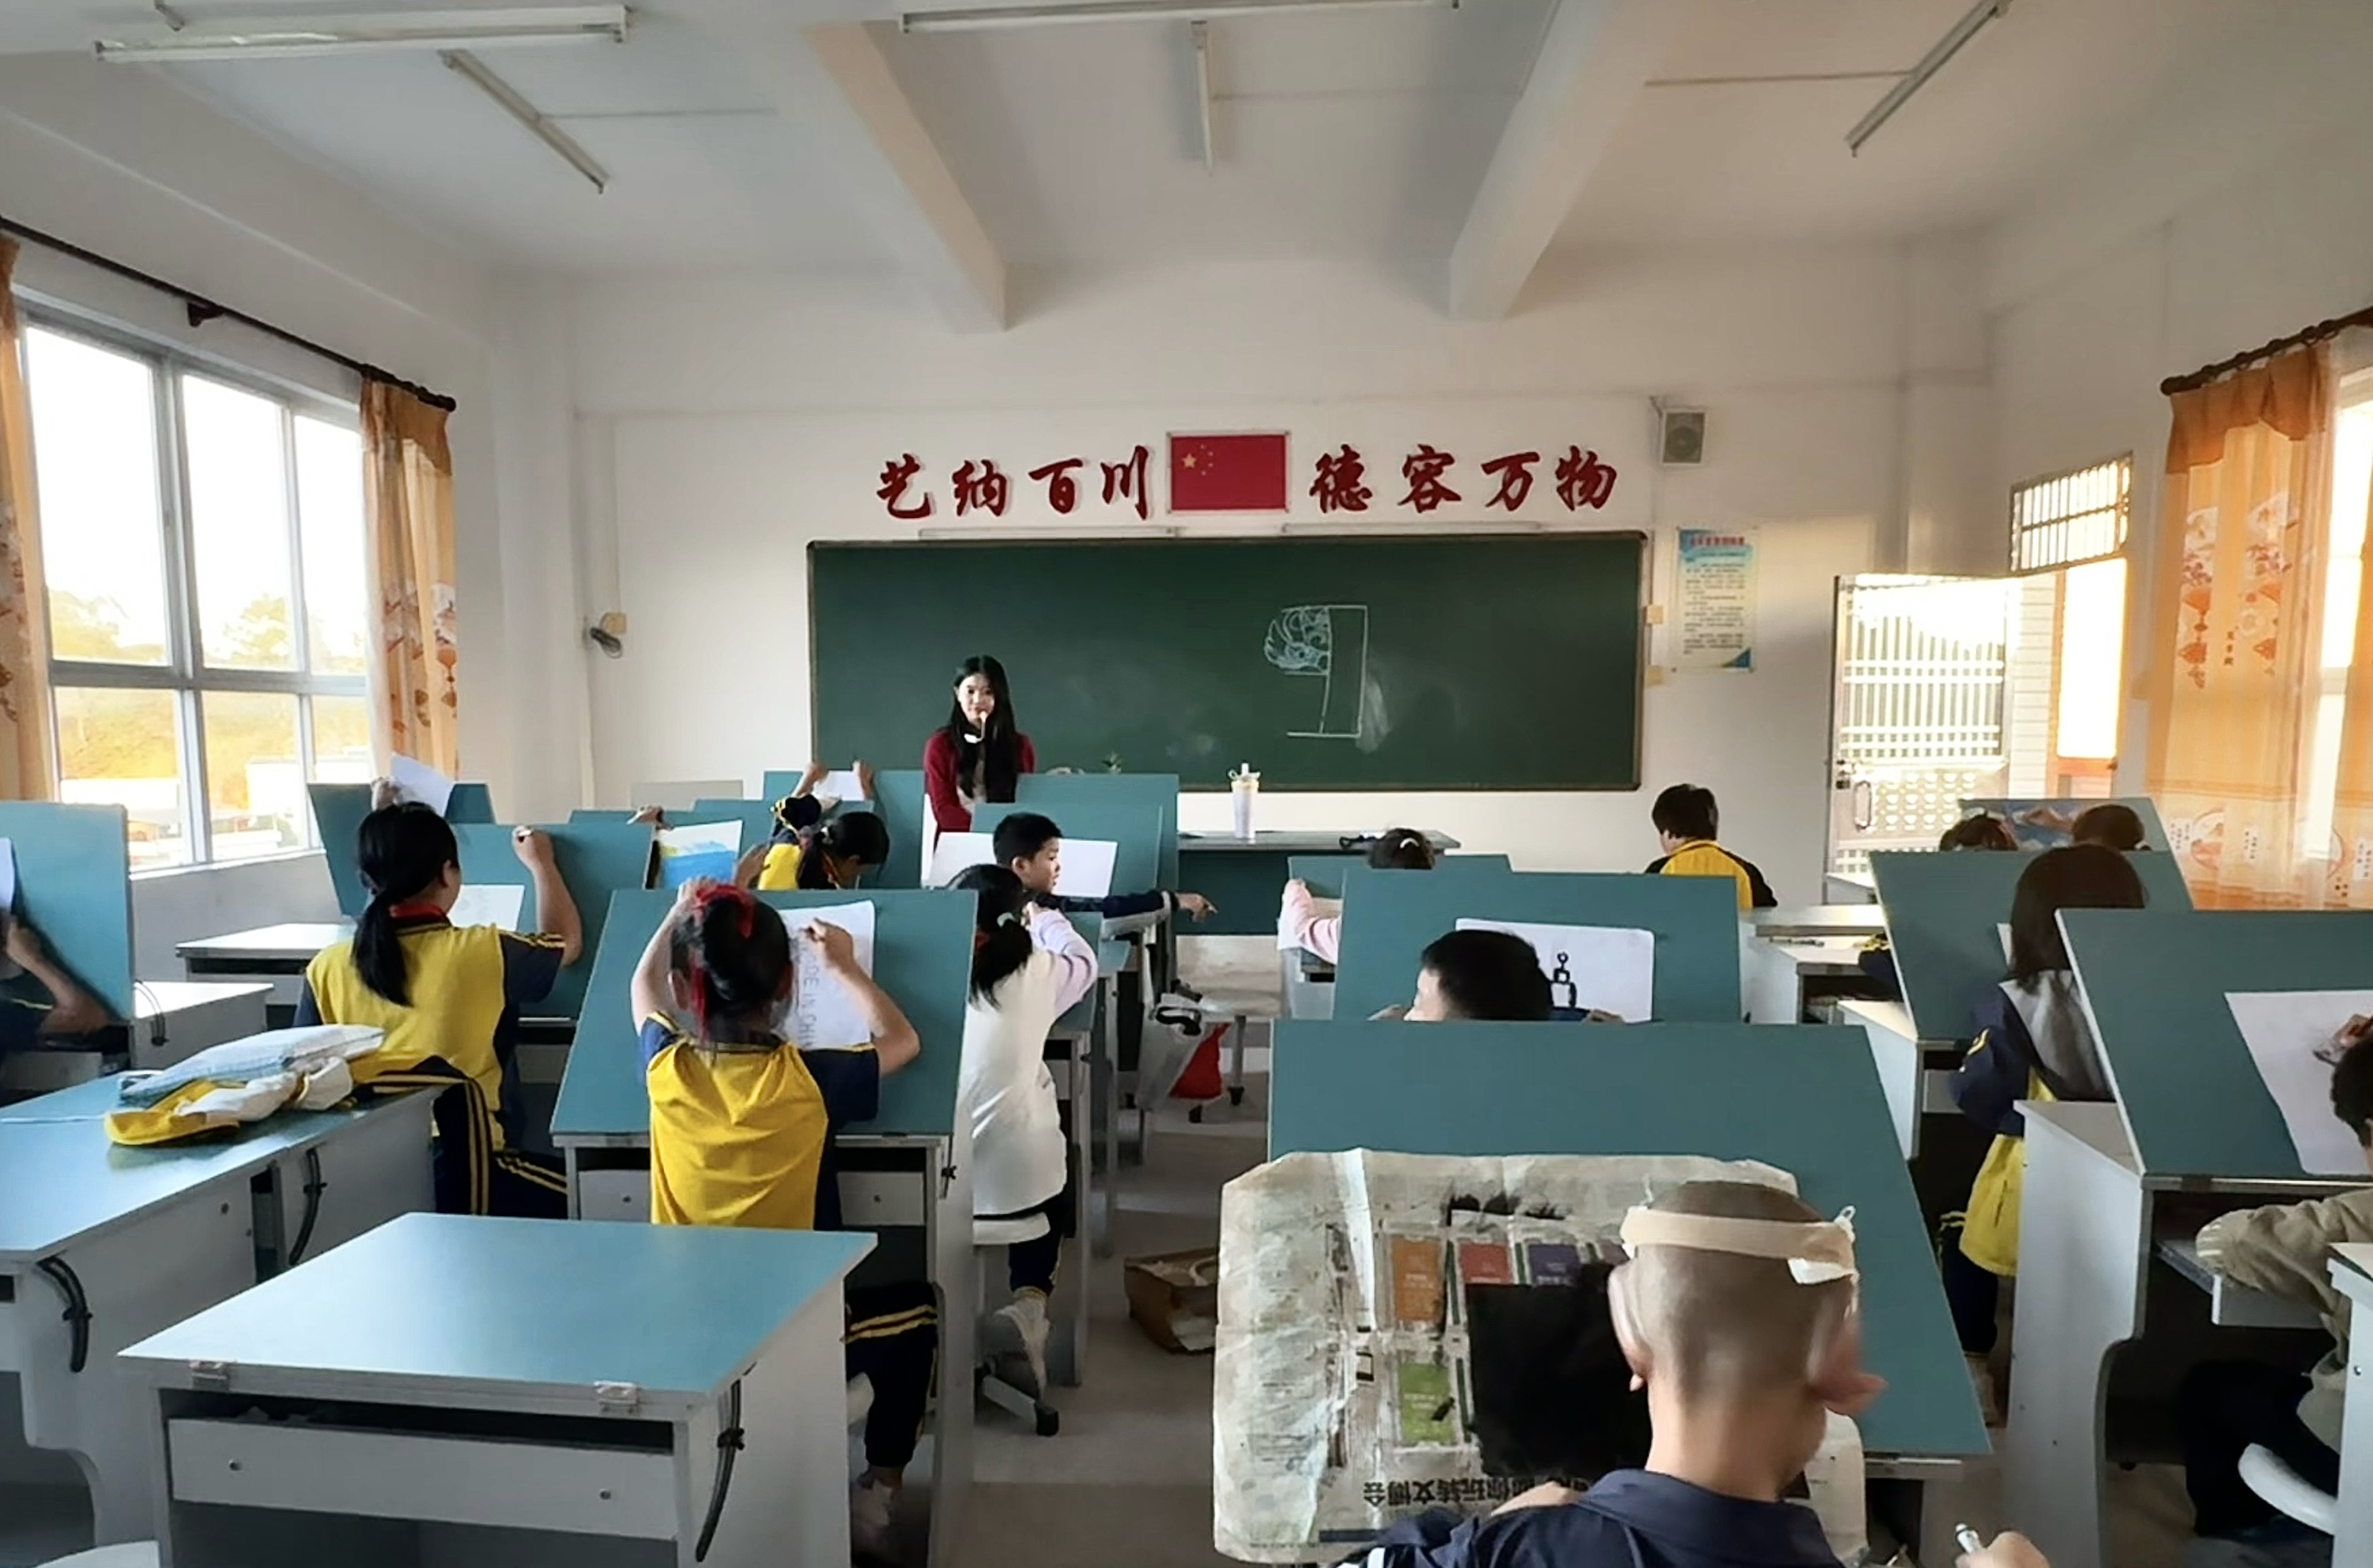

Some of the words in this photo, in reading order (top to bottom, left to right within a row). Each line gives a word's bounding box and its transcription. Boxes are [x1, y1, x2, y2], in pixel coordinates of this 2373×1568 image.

[877, 445, 1149, 520] 艺纳百川
[1308, 444, 1617, 513] 德容万物
